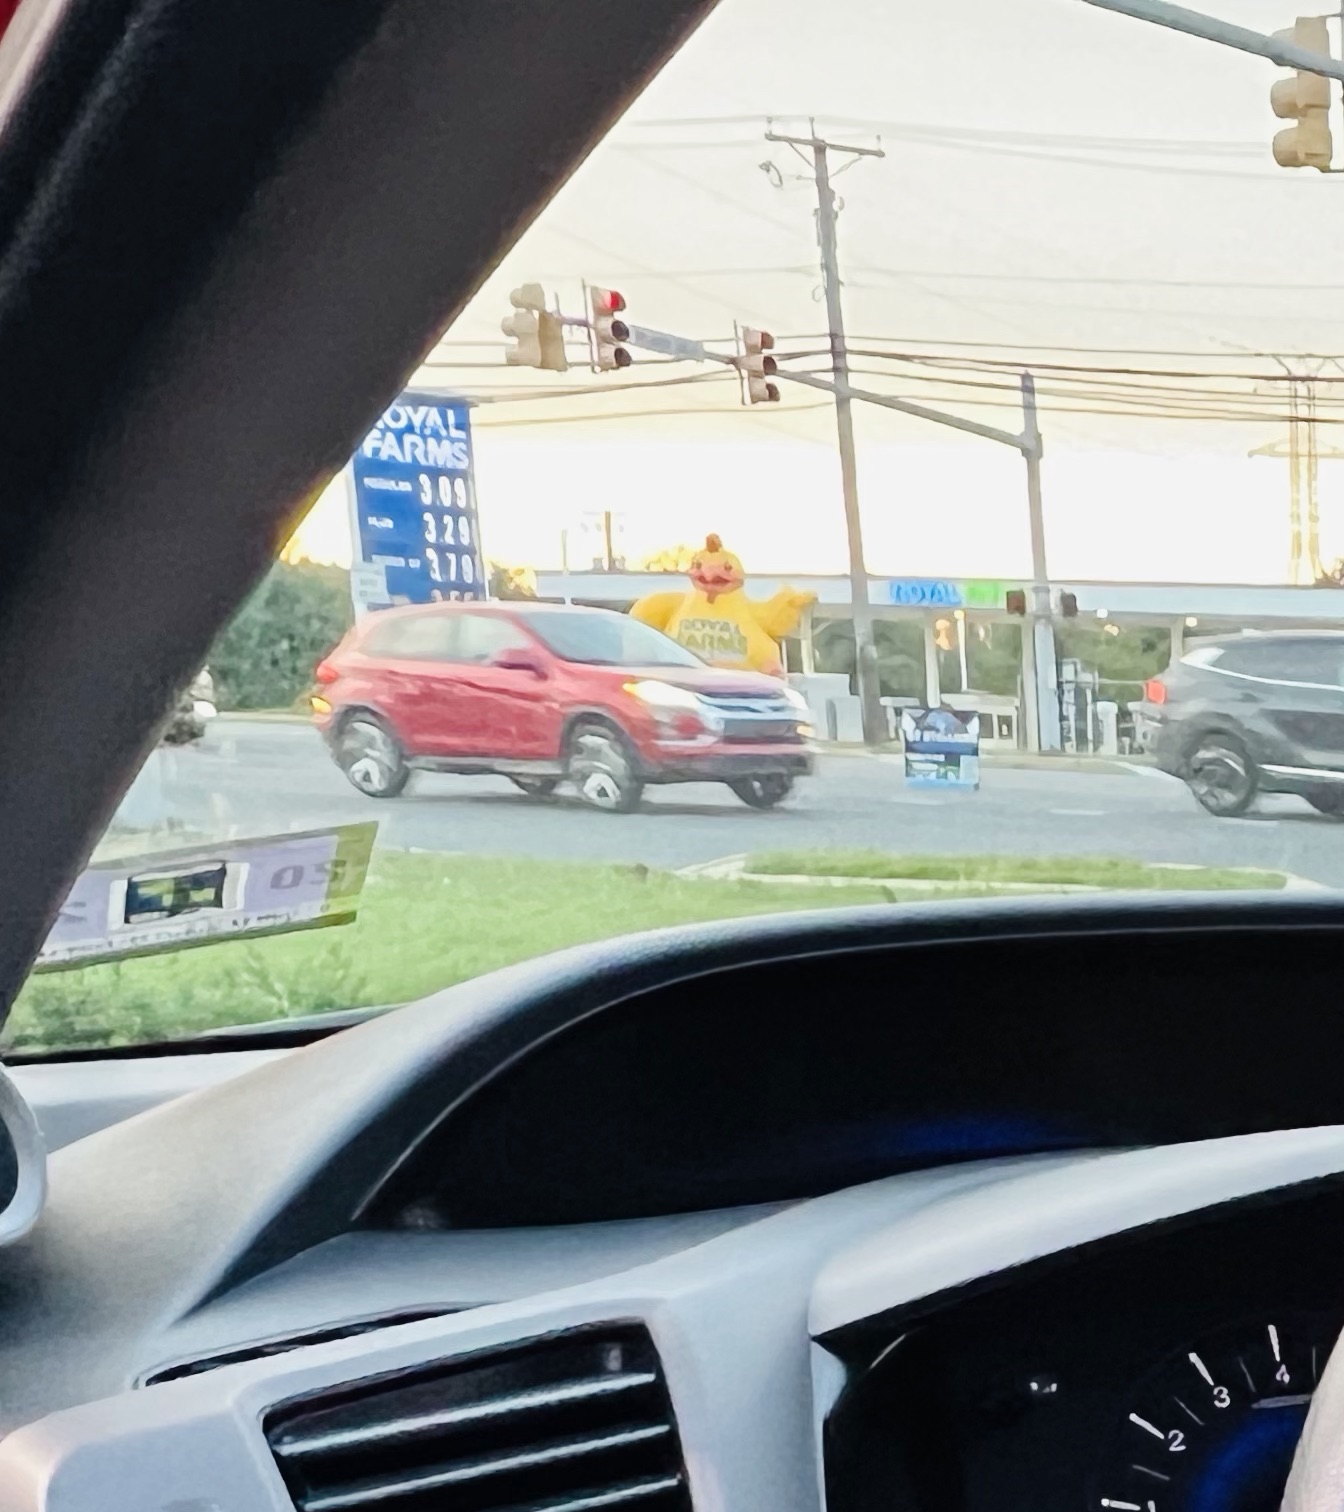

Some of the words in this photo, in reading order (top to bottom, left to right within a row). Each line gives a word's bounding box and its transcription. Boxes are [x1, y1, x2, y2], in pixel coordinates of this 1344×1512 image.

[362, 428, 470, 469] FARMS
[1275, 1363, 1291, 1385] 4
[1213, 1386, 1231, 1408] 3
[1167, 1429, 1187, 1451] 2
